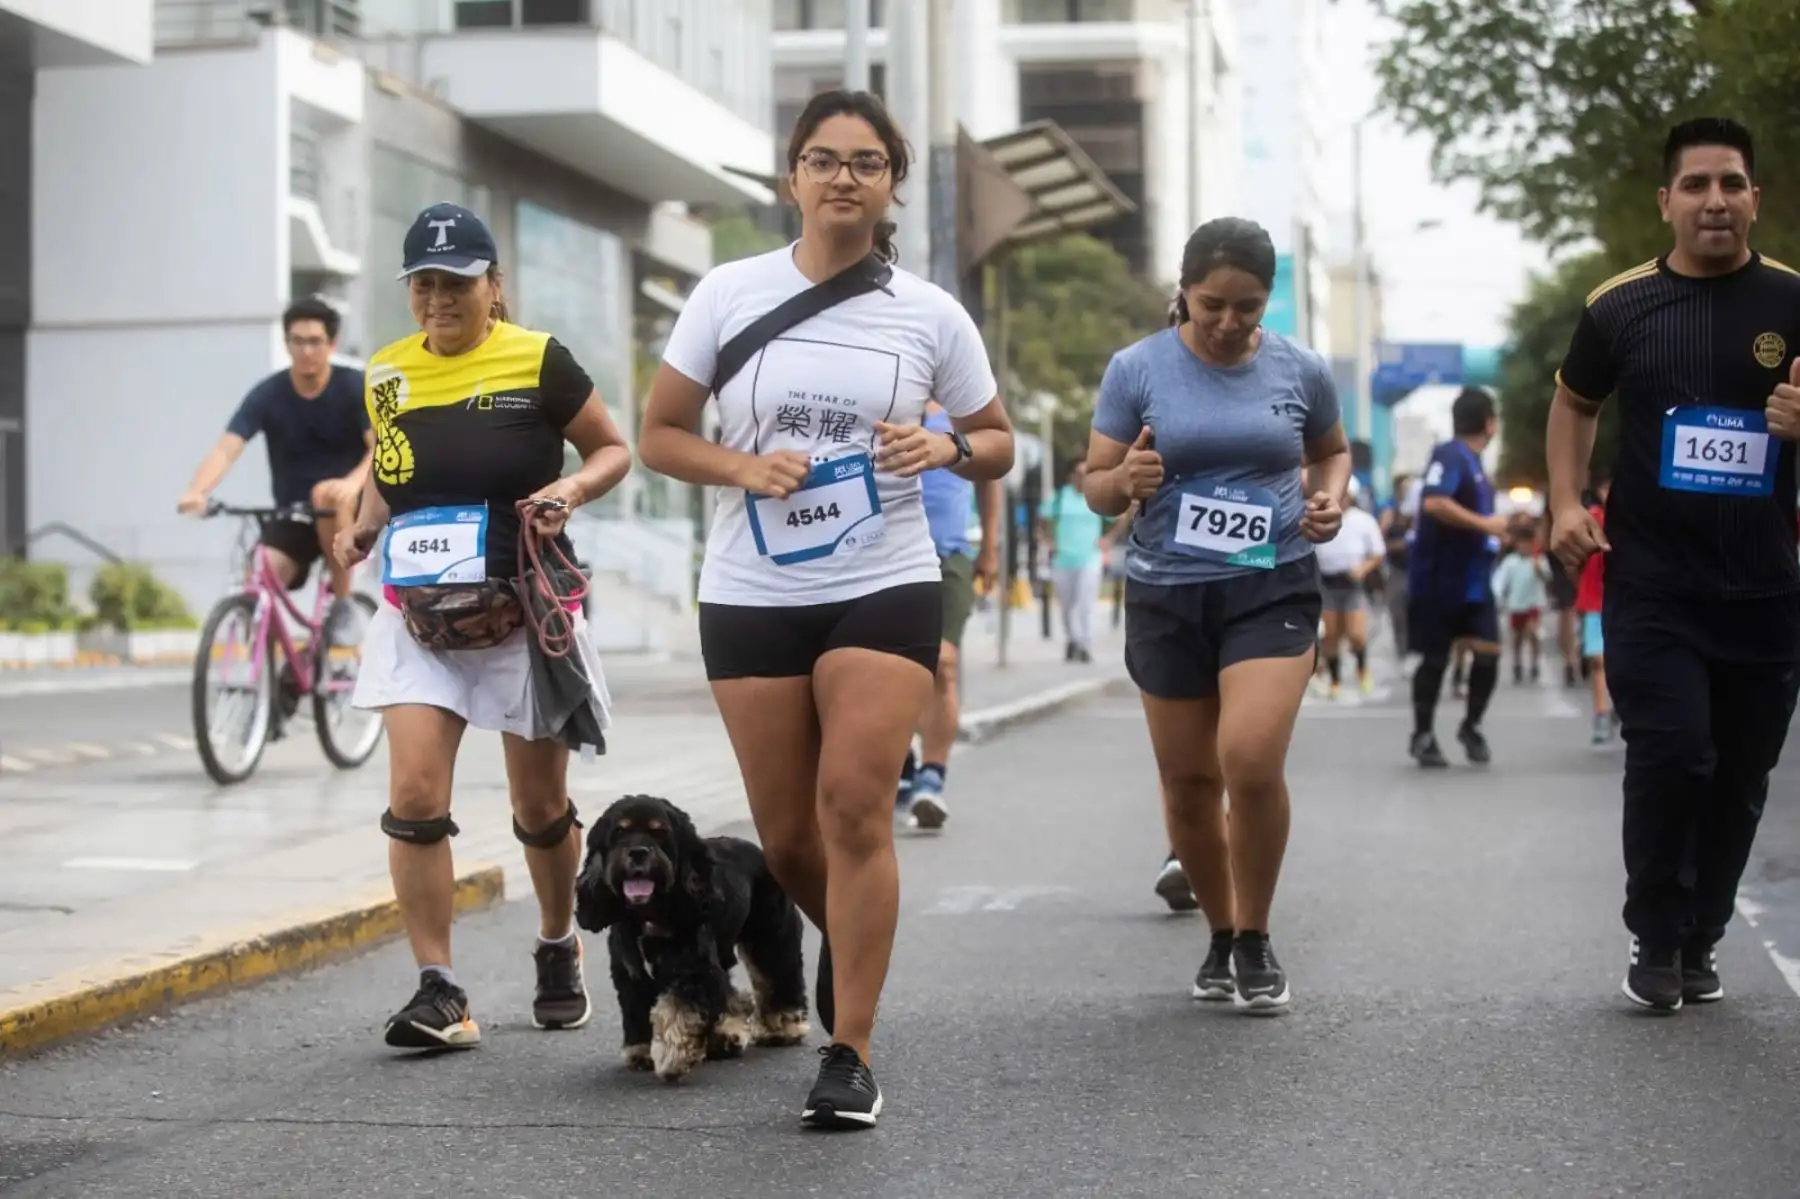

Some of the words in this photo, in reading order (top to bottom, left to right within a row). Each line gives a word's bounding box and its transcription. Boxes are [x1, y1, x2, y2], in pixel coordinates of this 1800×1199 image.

[788, 390, 806, 400] THE
[812, 393, 838, 405] YEAR
[843, 398, 857, 407] OF
[776, 403, 858, 444] 榮耀
[1717, 417, 1745, 429] LIMA
[1686, 436, 1748, 465] 1631
[786, 502, 841, 528] 4544
[1190, 504, 1267, 542] 7926
[408, 538, 451, 554] 4541
